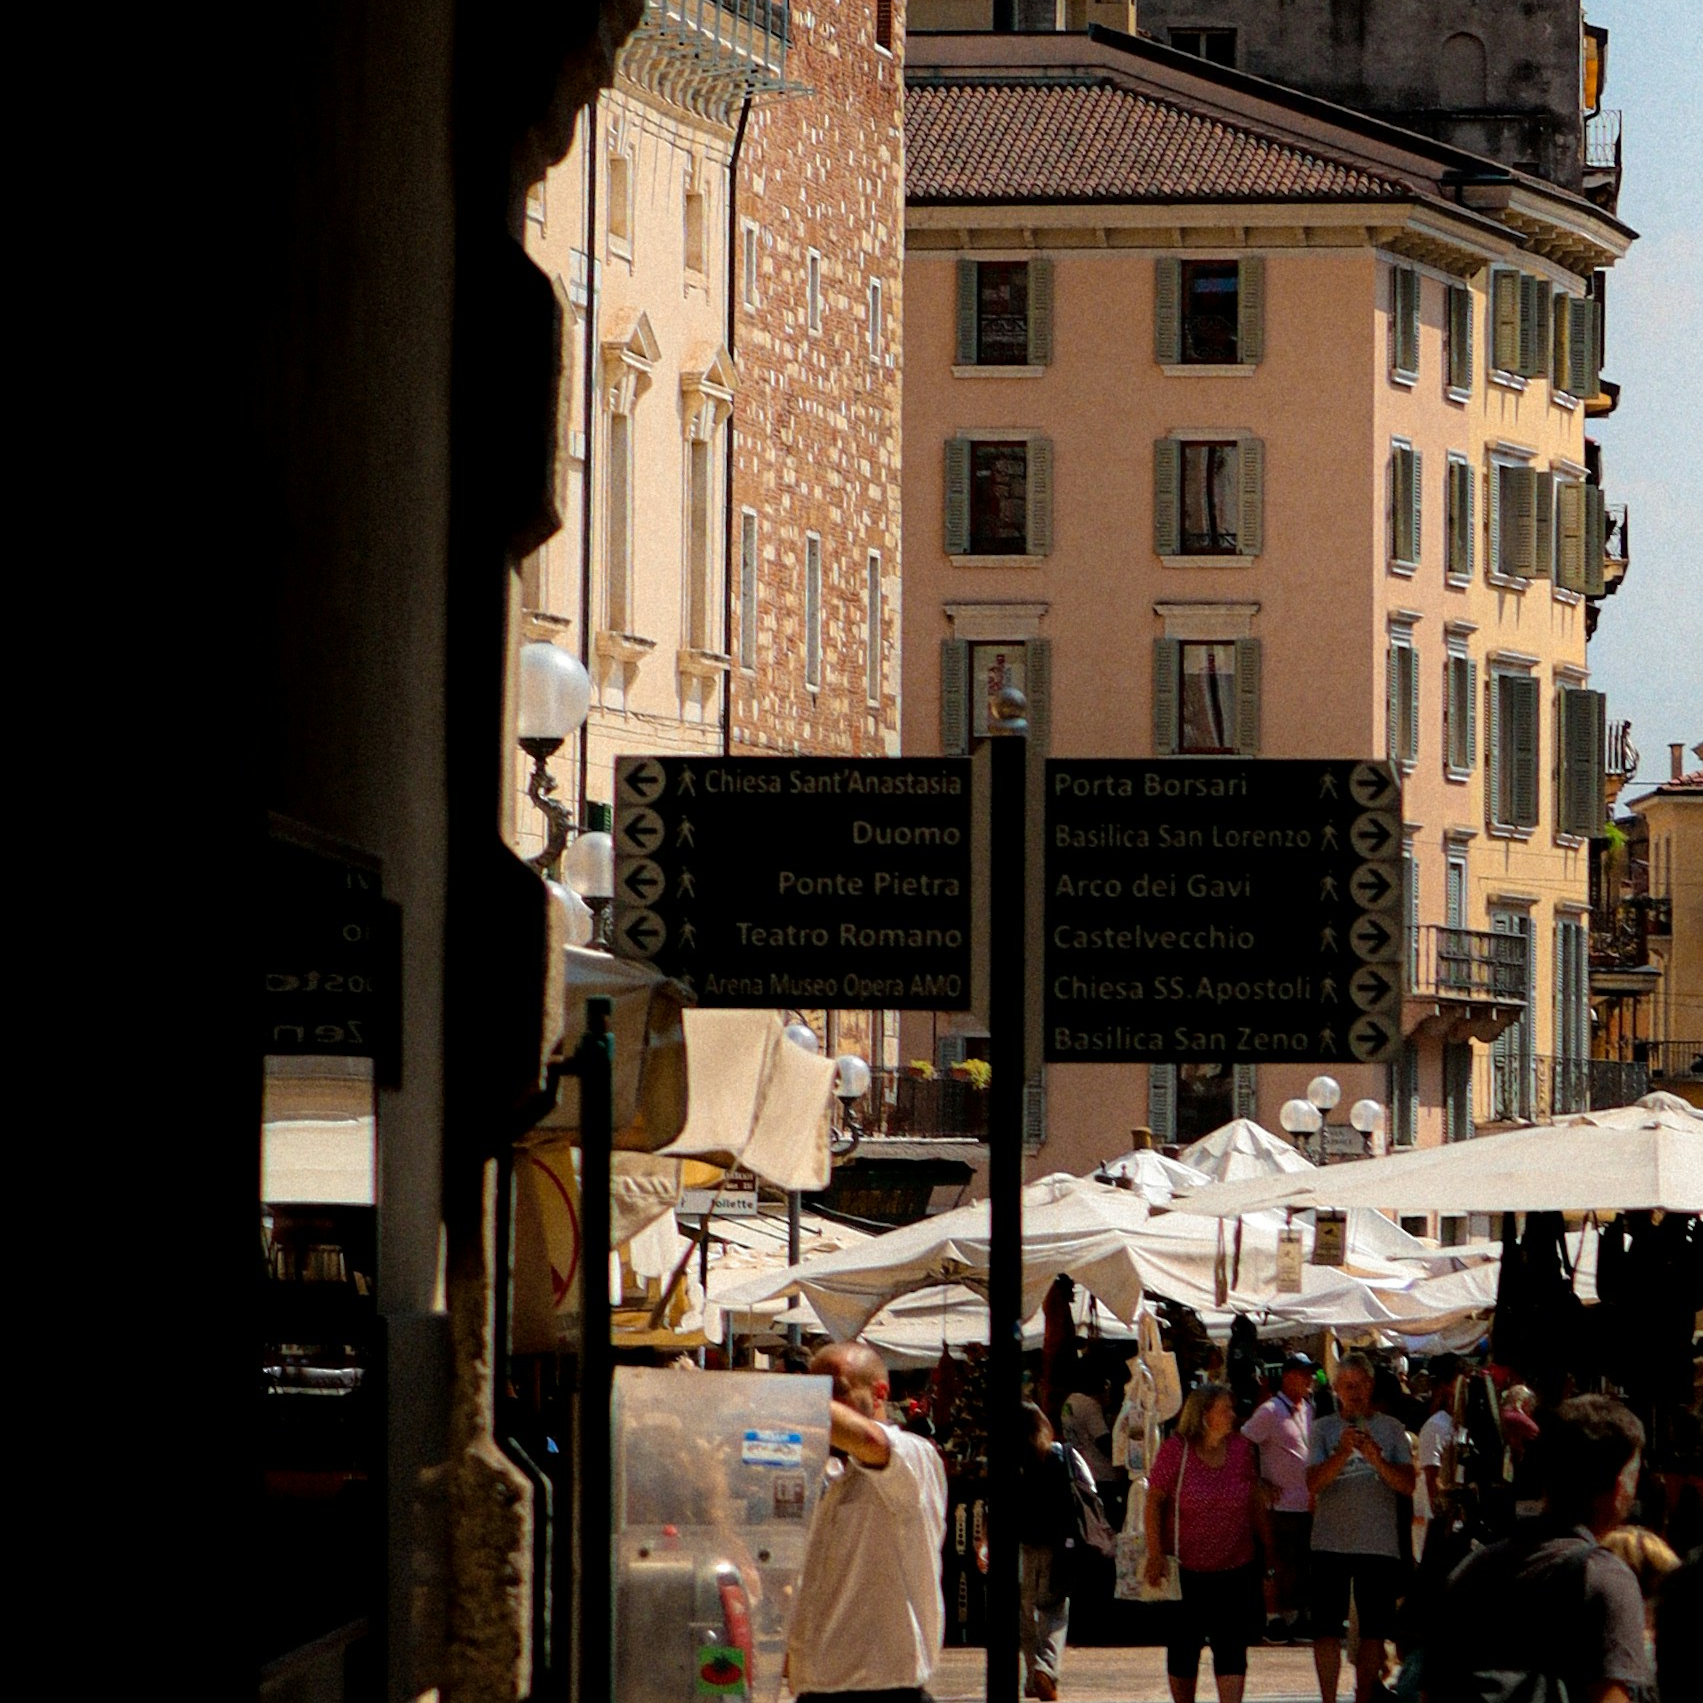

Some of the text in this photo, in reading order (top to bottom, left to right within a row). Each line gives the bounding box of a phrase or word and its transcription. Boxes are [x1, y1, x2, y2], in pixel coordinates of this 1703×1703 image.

[705, 768, 782, 794] Chiesa
[1055, 772, 1247, 797] Porta Borsari
[852, 820, 961, 845] Duomo
[1055, 823, 1311, 848] Basilica San Lorenzo
[778, 871, 960, 897] Ponte Pietra
[1055, 873, 1250, 898] Arco dei Gavi
[735, 922, 962, 948] Teatro Romano
[1054, 924, 1254, 949] Castelvecchio
[705, 973, 962, 1001] Arena Museo Opera AMO
[1054, 975, 1144, 1000] Chiesa
[1054, 1026, 1308, 1051] Basilica San Zeno
